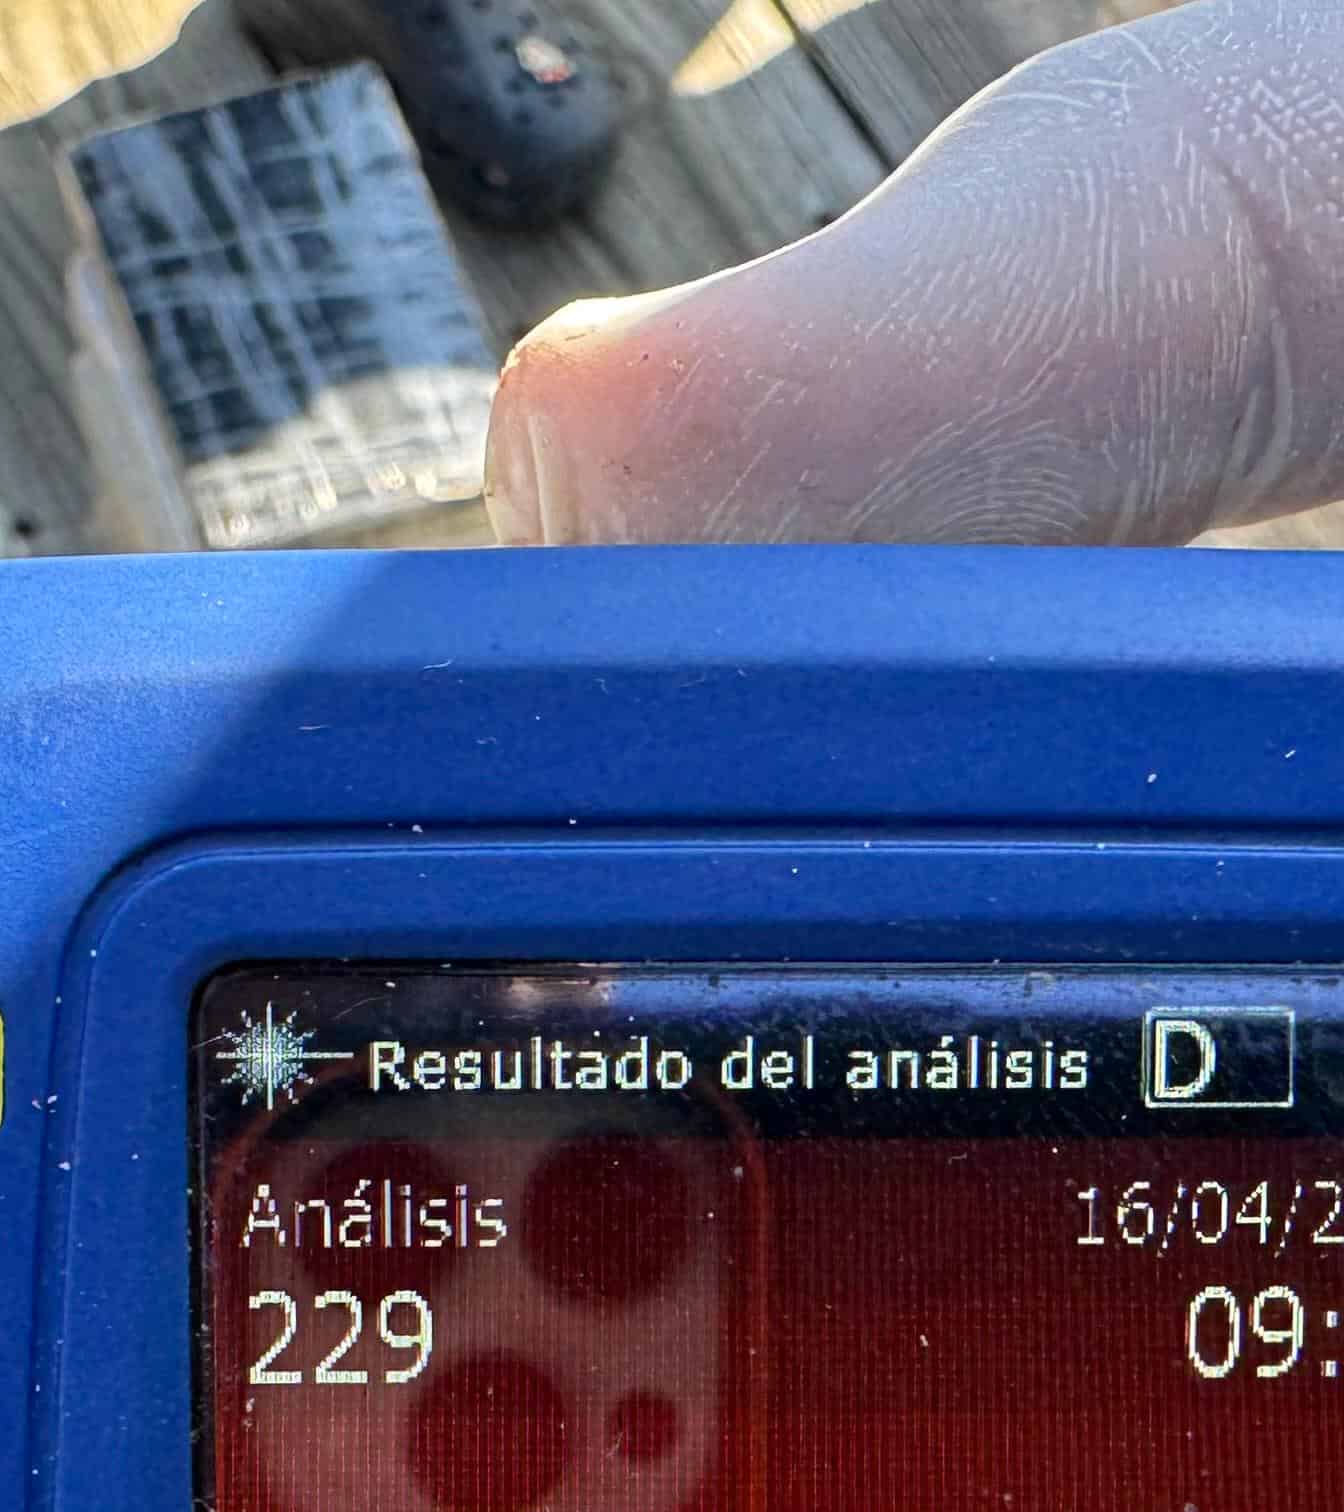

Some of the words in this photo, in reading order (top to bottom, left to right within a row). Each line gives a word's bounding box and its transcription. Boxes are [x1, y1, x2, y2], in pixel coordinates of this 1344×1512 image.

[369, 1035, 693, 1092] Resultado
[721, 1036, 814, 1090] del
[845, 1034, 1088, 1090] análisis
[1154, 1019, 1217, 1098] D
[242, 1179, 508, 1249] Análisis
[248, 1289, 435, 1385] 229
